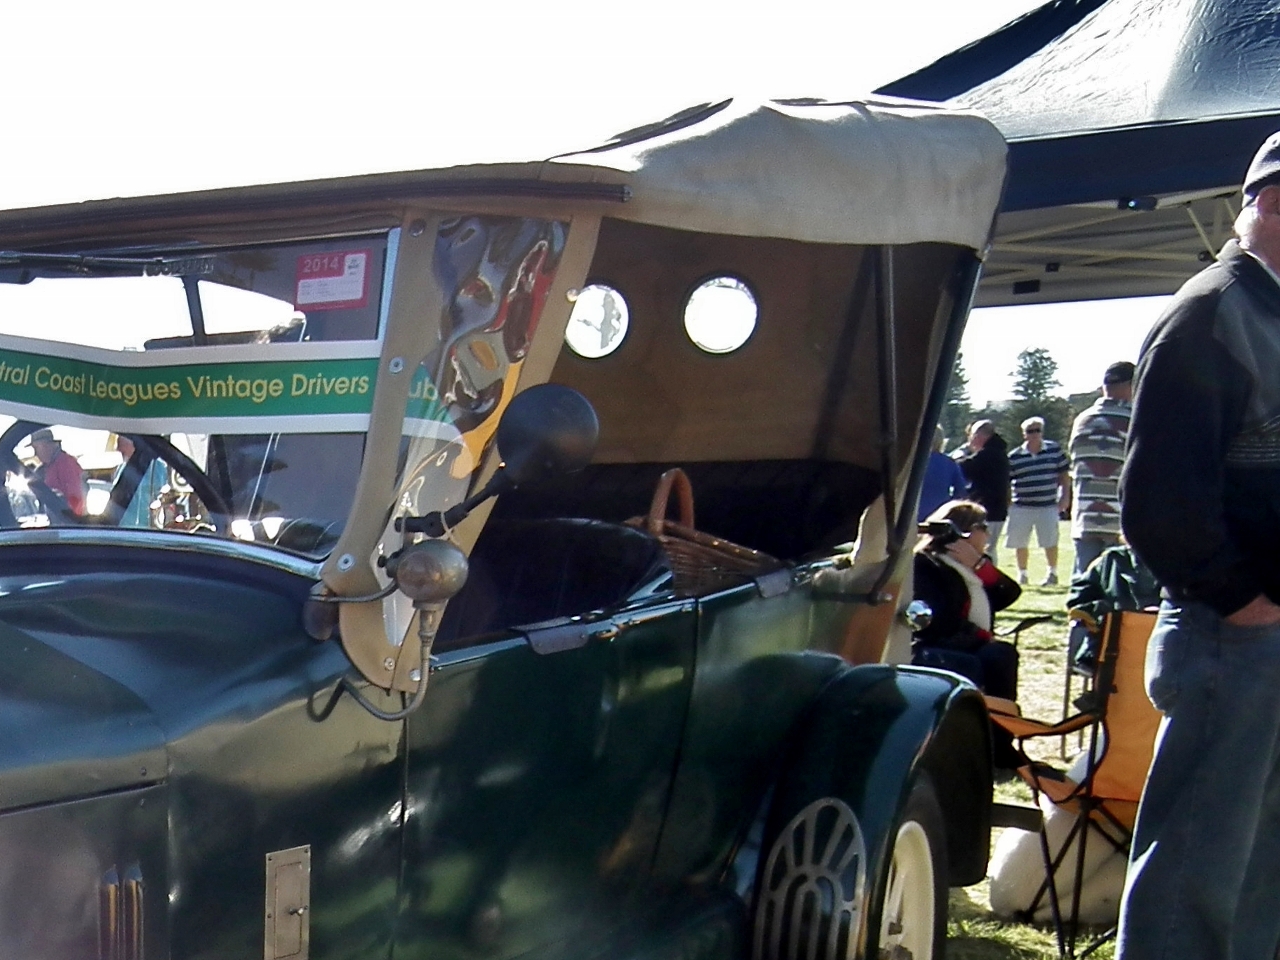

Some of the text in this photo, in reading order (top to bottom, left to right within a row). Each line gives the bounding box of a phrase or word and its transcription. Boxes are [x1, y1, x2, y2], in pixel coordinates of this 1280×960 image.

[303, 256, 339, 274] 2014
[34, 366, 86, 394] Coast
[89, 375, 182, 406] Leagues
[187, 374, 284, 403] Vintage
[291, 372, 370, 397] Drivers
